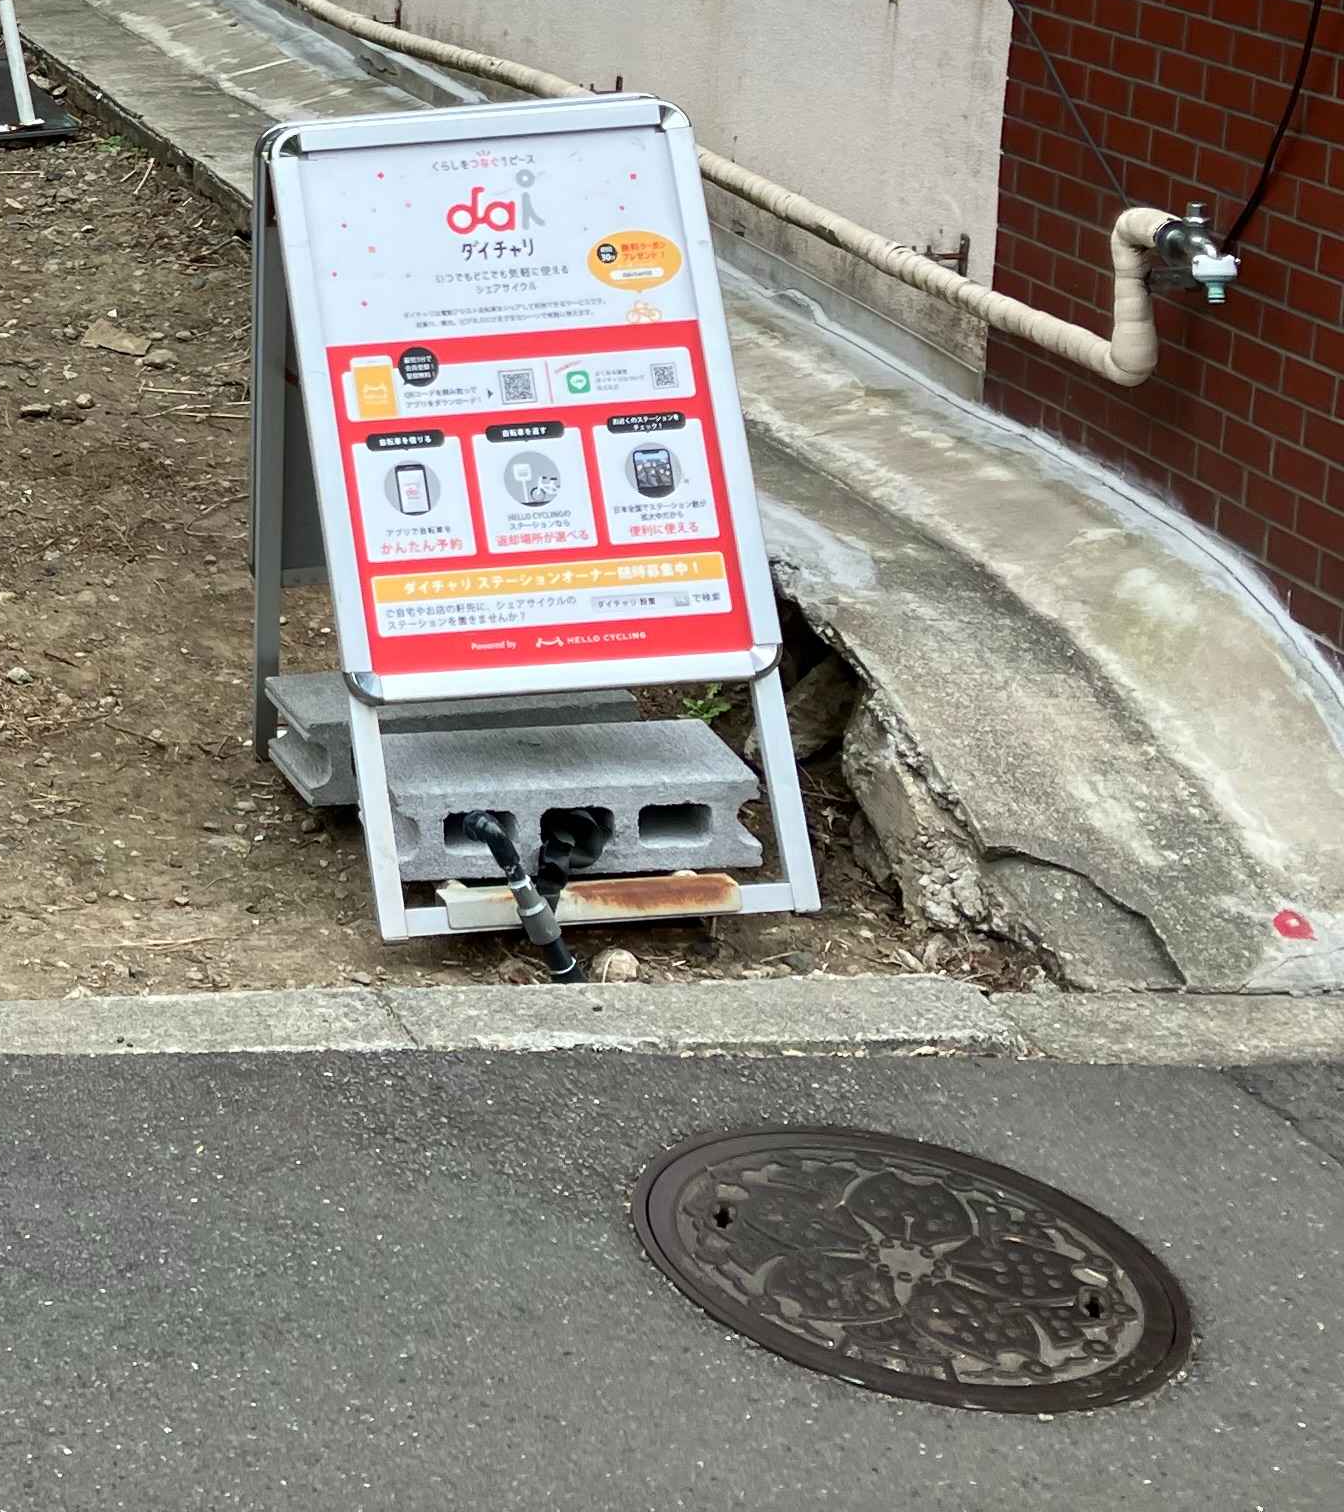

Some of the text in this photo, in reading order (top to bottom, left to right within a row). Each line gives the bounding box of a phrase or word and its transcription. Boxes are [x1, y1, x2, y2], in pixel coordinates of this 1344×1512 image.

[461, 238, 535, 261] ダイチャリ
[380, 538, 464, 556] かんたん予約
[403, 576, 472, 595] ダイチャリ
[566, 631, 647, 645] HELLO CYCLING
